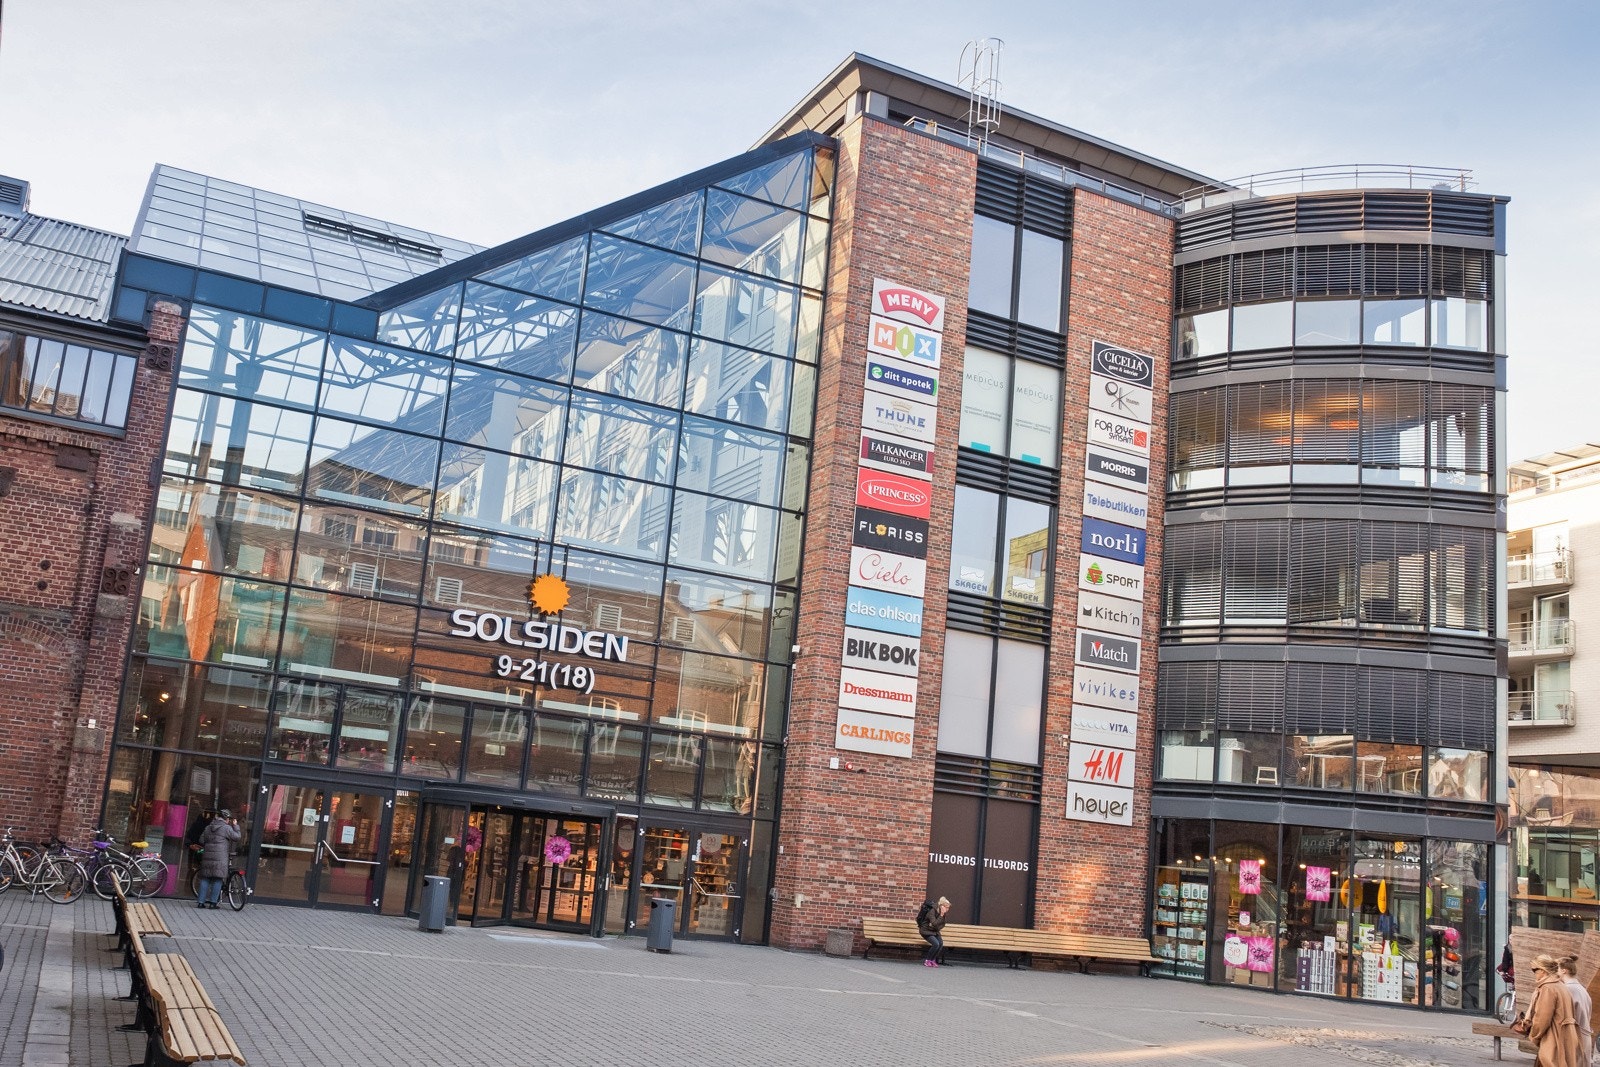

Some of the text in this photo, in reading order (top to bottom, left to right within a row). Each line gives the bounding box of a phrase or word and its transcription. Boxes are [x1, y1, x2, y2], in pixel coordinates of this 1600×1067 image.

[886, 293, 934, 316] MENY
[877, 327, 933, 356] MIX
[1104, 351, 1143, 372] CICELIA
[884, 370, 932, 390] ditt apotek
[965, 373, 1004, 389] MEDICUS
[1016, 386, 1054, 402] MEDICUS
[875, 406, 926, 428] THUNE
[1094, 418, 1113, 433] FOR
[871, 441, 924, 463] FALKANGER
[883, 455, 911, 467] EURO SKO
[1100, 460, 1136, 477] MORRIS
[873, 485, 921, 503] PRINCESS
[1087, 493, 1146, 517] Telebutikken
[1090, 533, 1139, 555] norli
[859, 553, 912, 585] Cielo
[955, 579, 988, 592] SKAGEN
[1106, 573, 1141, 589] SPORT
[1007, 589, 1039, 602] SKAGEN
[848, 600, 921, 624] clas ohlson
[451, 608, 629, 662] SOLSIDEN
[846, 637, 918, 667] BIK BOK
[1089, 641, 1129, 663] Match
[496, 654, 596, 695] 9-21(18)
[843, 682, 914, 703] Dressmann
[1079, 680, 1136, 701] vivikes
[840, 723, 912, 745] CARLINGS
[1109, 722, 1129, 734] VITA
[1083, 748, 1124, 784] H&M
[1074, 792, 1129, 819] høyer
[928, 852, 977, 867] TILBORDS
[983, 858, 1029, 872] TILBORDS
